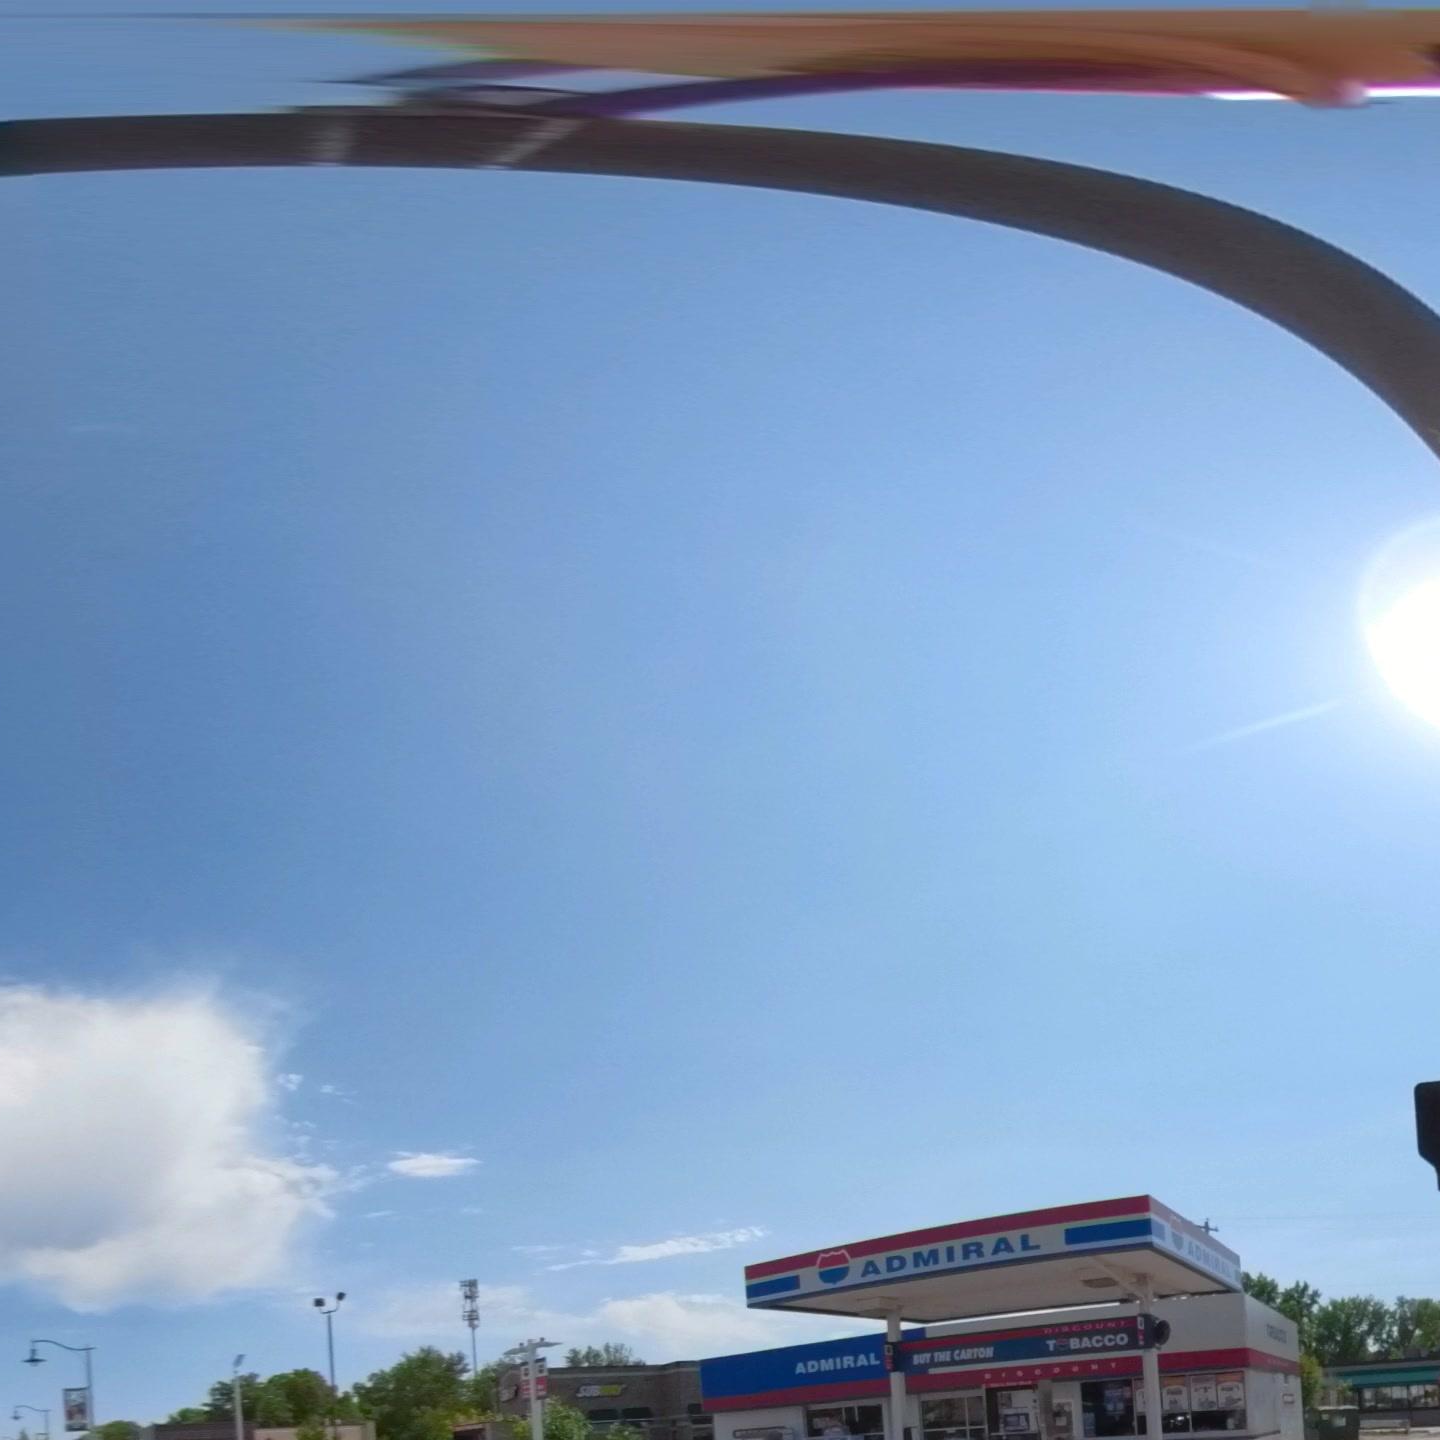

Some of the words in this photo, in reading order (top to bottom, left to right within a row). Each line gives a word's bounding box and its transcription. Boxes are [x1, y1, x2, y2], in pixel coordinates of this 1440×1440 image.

[861, 1234, 1041, 1277] ADMIRAL
[1044, 1320, 1125, 1334] DISCOUNT
[795, 1353, 880, 1375] ADMIRAL
[913, 1354, 931, 1366] BUY
[933, 1350, 952, 1363] THE
[953, 1347, 994, 1361] CARTON
[985, 1362, 1116, 1380] DISCOUNT
